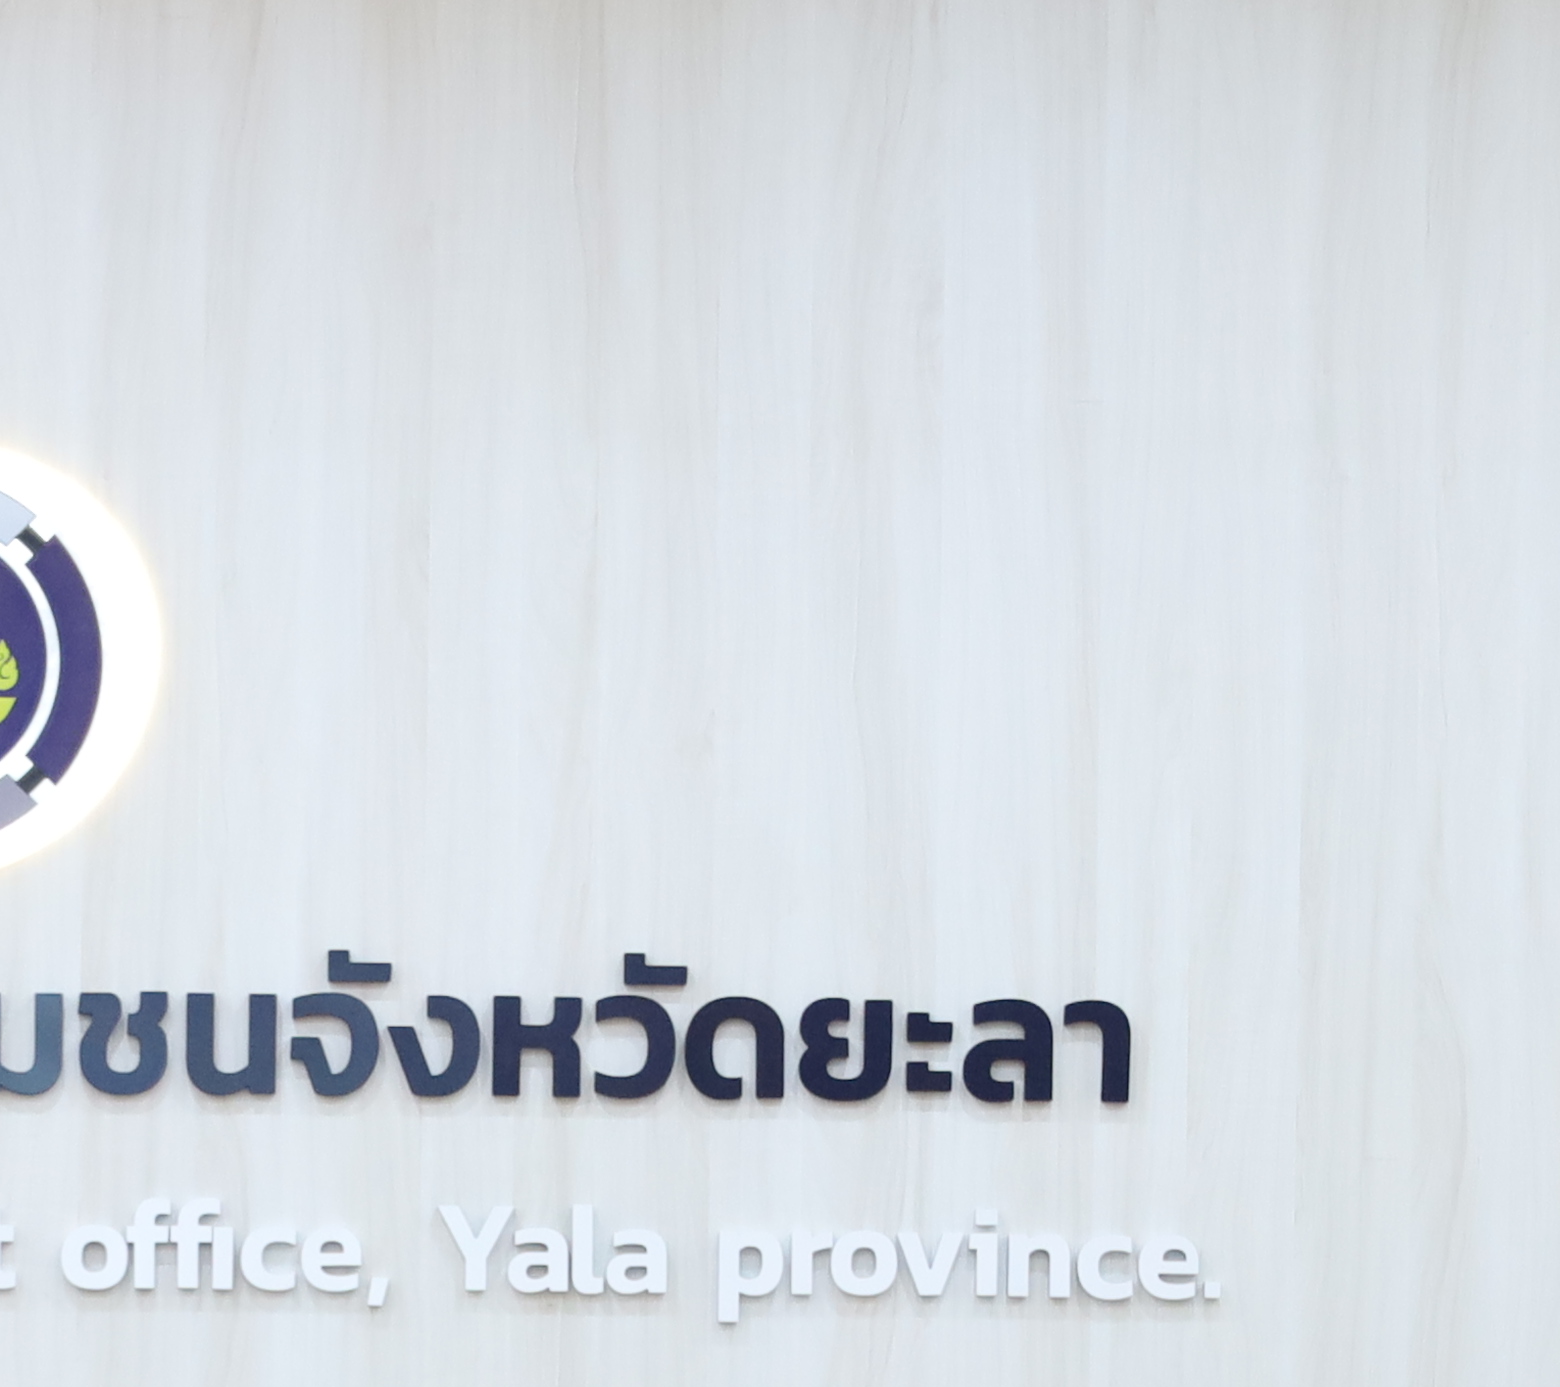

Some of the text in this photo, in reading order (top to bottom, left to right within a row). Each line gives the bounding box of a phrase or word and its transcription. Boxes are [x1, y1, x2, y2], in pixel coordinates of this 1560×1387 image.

[61, 1198, 391, 1307] office,
[438, 1203, 668, 1295] Yala
[717, 1208, 1222, 1324] province.
